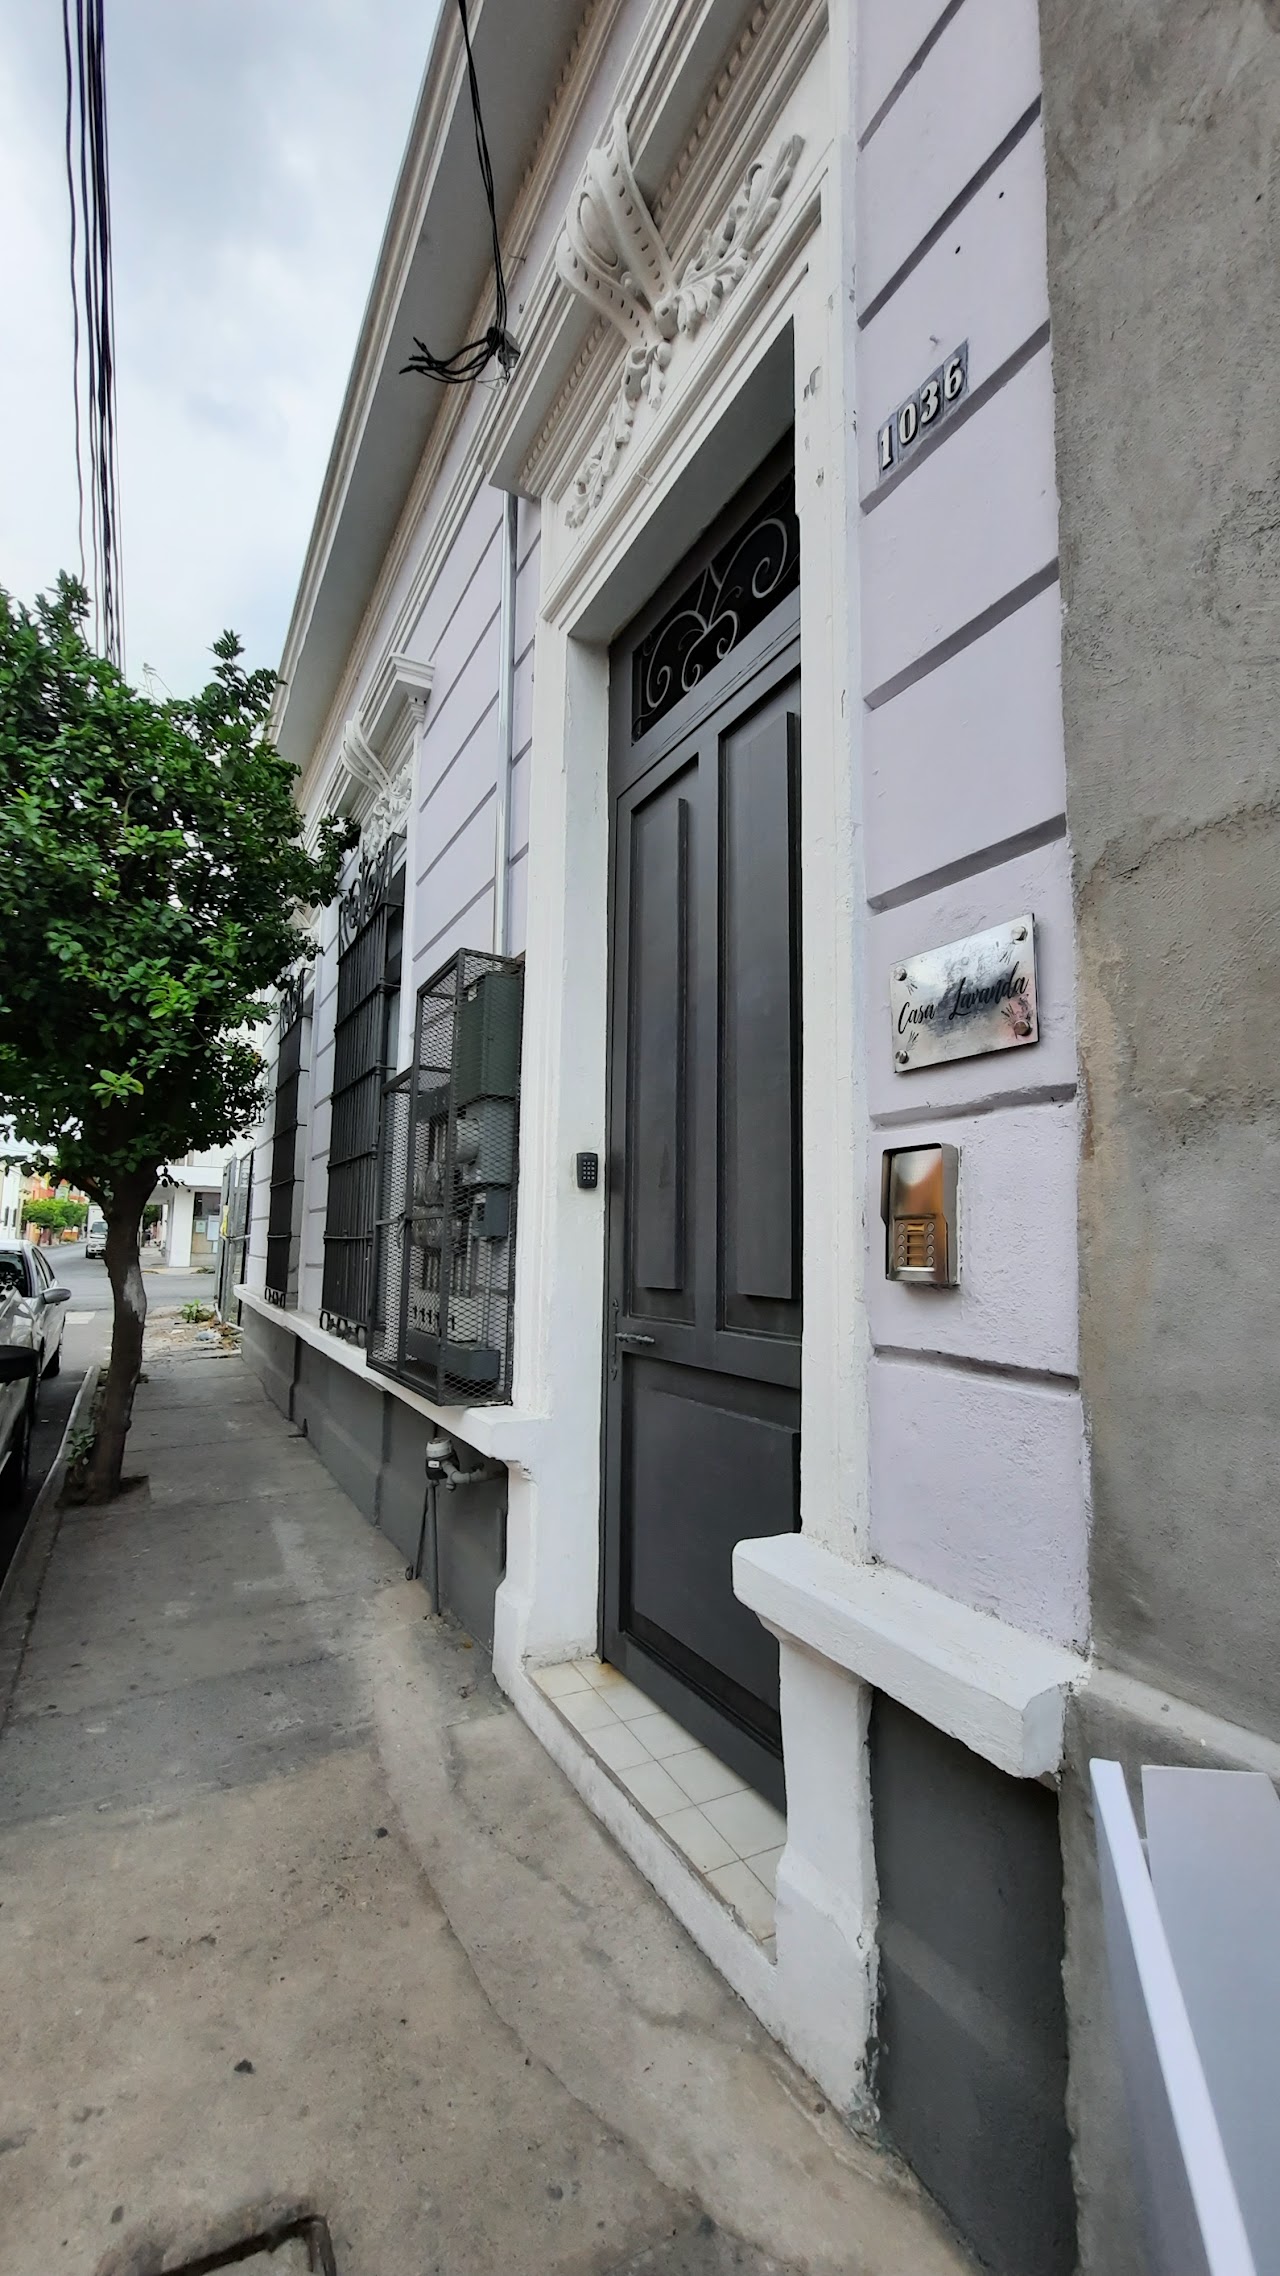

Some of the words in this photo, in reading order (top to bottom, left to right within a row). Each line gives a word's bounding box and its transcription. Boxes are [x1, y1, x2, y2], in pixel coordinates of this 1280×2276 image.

[881, 358, 965, 470] 1036
[898, 1002, 935, 1034] Casa
[949, 961, 1029, 1020] Lavanda
